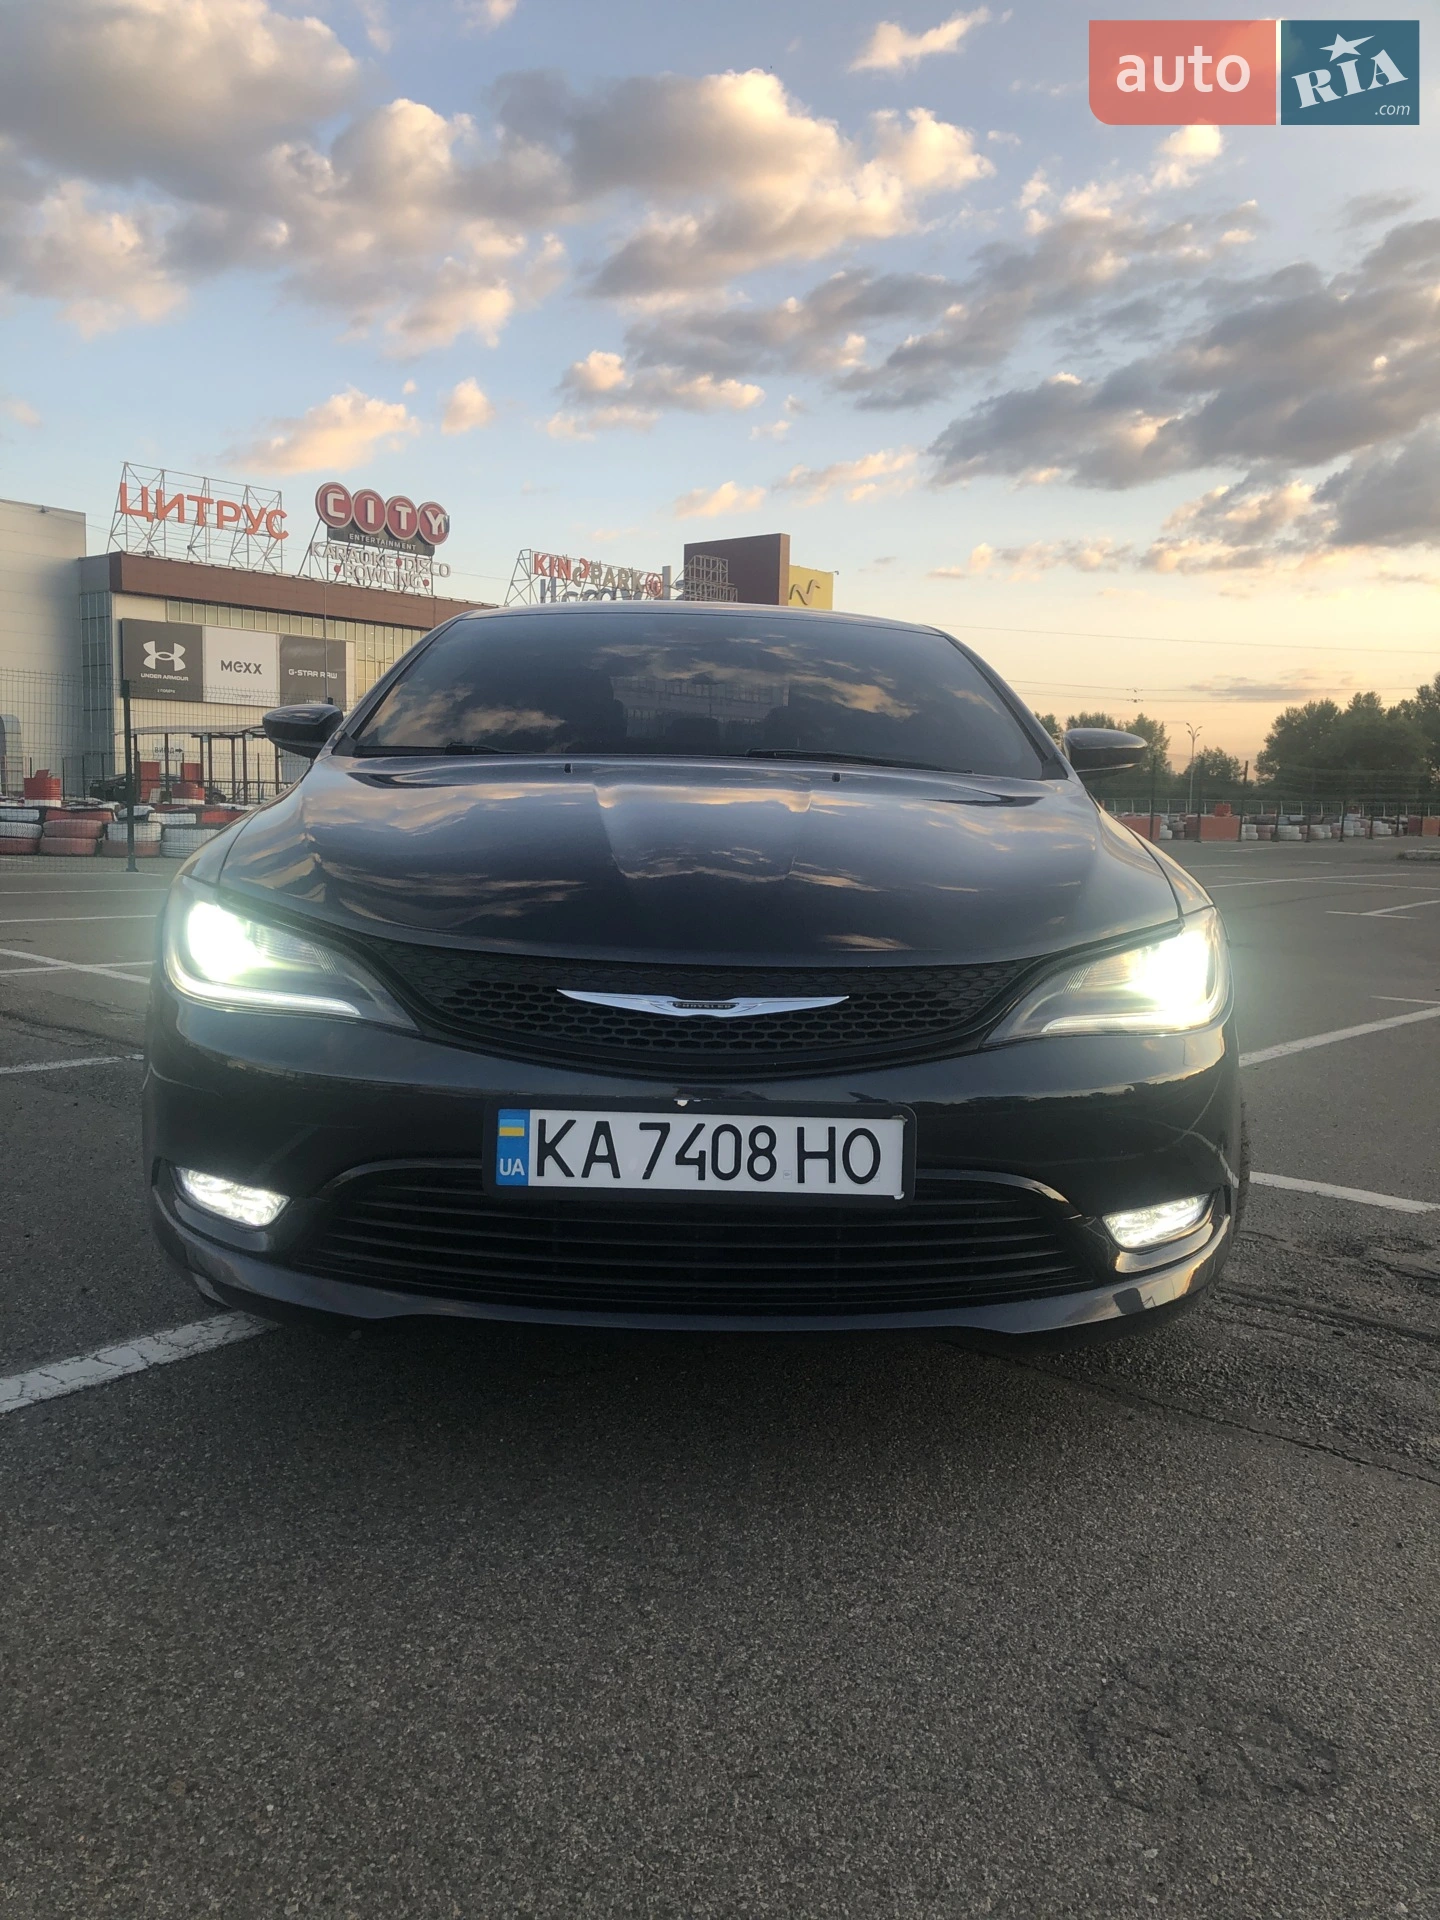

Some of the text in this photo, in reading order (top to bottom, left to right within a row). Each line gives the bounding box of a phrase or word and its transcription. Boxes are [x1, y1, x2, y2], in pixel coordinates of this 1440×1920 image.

[119, 482, 289, 540] ЦИТРУС
[326, 492, 446, 535] CITY
[349, 533, 417, 551] ENTERTAINMENT
[311, 542, 451, 577] KARAOKE DISCO
[343, 563, 421, 588] BOWLING
[590, 562, 643, 590] PARK
[288, 668, 338, 679] G-STAR RAW
[536, 1117, 881, 1185] KA 7408 HO
[499, 1157, 526, 1176] UA
